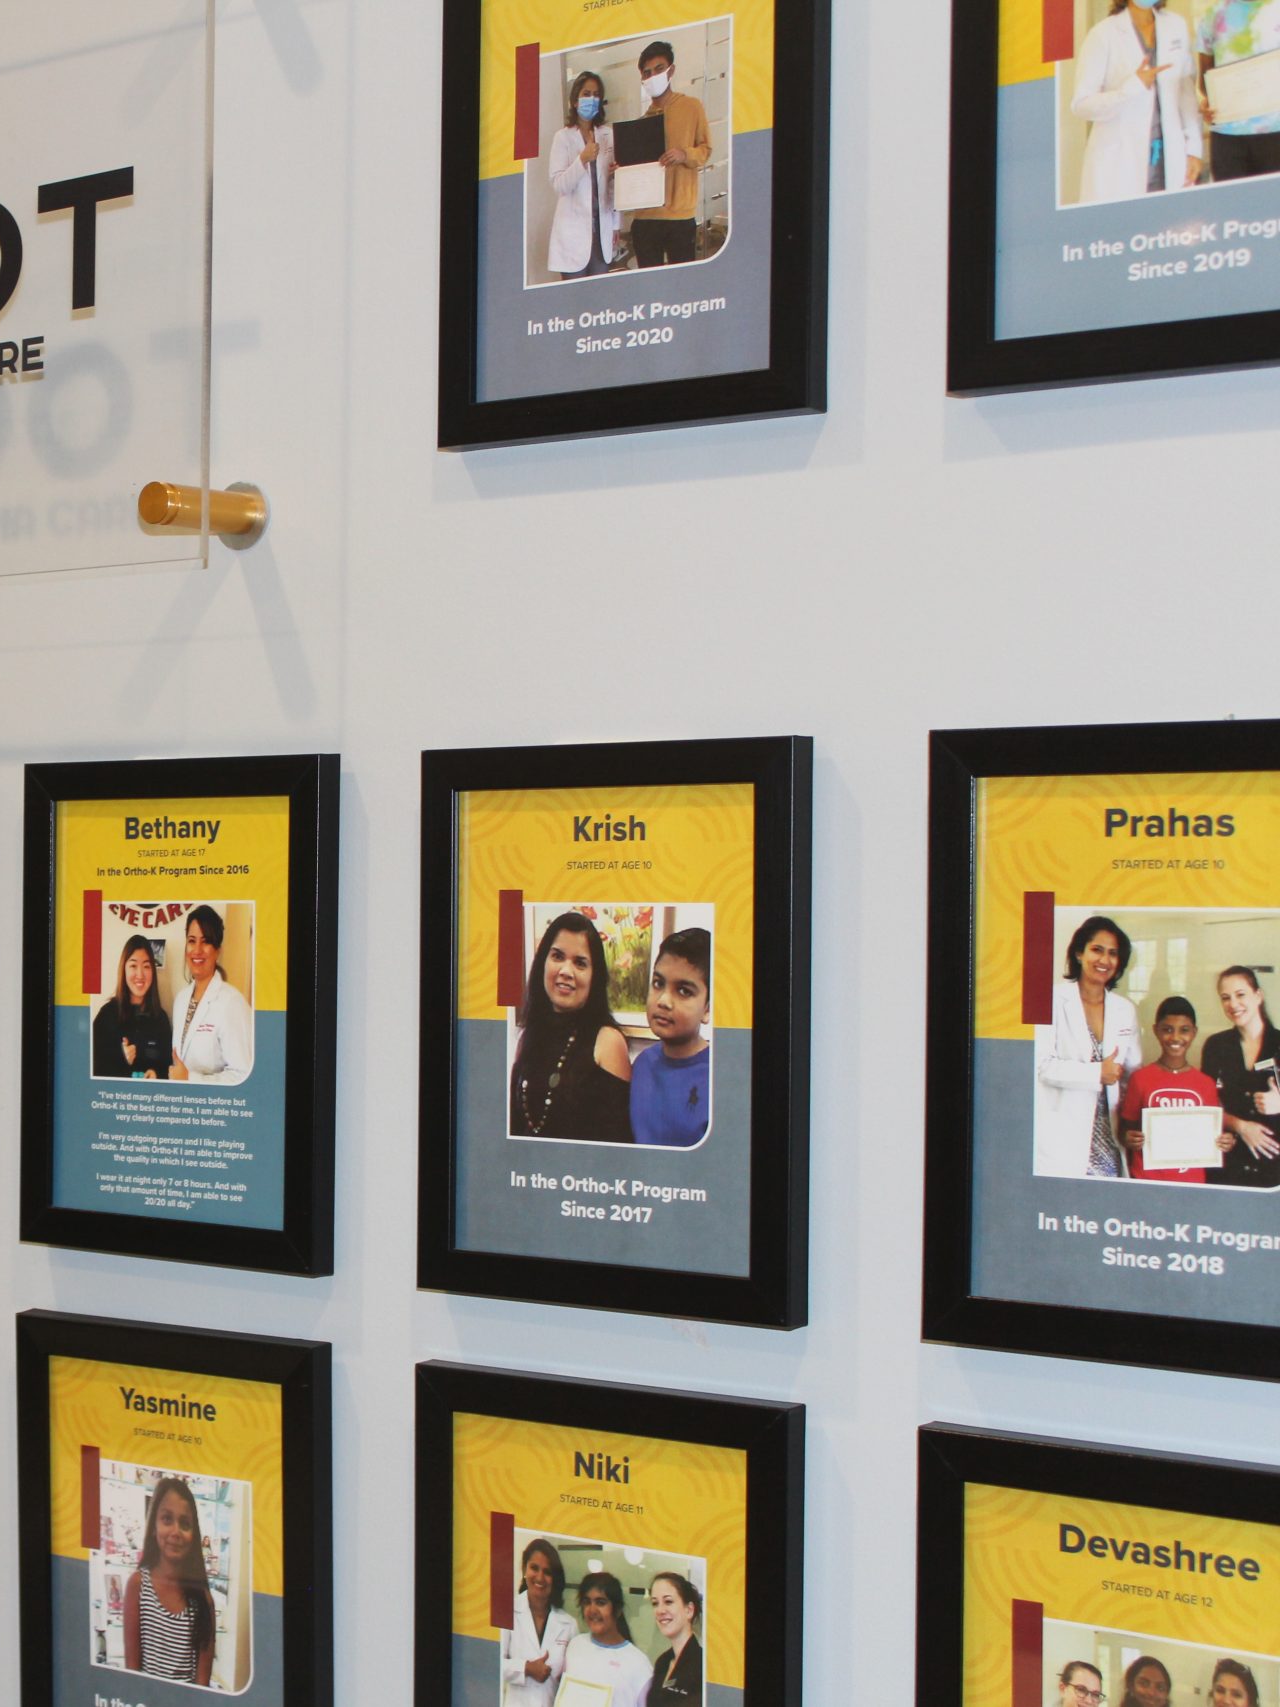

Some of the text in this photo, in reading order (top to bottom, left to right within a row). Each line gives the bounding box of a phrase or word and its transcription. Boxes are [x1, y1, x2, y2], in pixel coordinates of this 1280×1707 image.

[1062, 245, 1083, 262] In
[1090, 240, 1123, 258] the
[1130, 225, 1216, 251] Ortho-K
[1128, 249, 1250, 281] Since 2019
[528, 297, 726, 335] In the Ortho-K Program
[576, 327, 673, 354] Since 2020
[125, 816, 221, 844] Bethany
[574, 814, 646, 841] Krish
[1104, 807, 1235, 838] Prahas
[138, 850, 169, 858] STARTED
[171, 849, 179, 857] AT
[182, 849, 196, 857] AGE
[567, 861, 652, 870] STARTED AT AGE 10
[1112, 859, 1225, 870] STARTED AT AGE 10
[97, 864, 249, 878] In the Ortho-K Program Since 2016
[91, 1101, 118, 1110] Ortho-K
[126, 1103, 138, 1111] the
[140, 1103, 155, 1112] best
[170, 1105, 180, 1113] for
[213, 1107, 229, 1116] able
[231, 1109, 238, 1117] to
[115, 1092, 131, 1100] tried
[133, 1094, 151, 1102] many
[153, 1094, 182, 1103] different
[184, 1096, 207, 1104] lenses
[208, 1097, 232, 1106] before
[234, 1098, 246, 1107] but
[116, 1113, 227, 1126] very clearly compared to before.
[510, 1171, 706, 1202] In the Ortho-K Program
[561, 1201, 652, 1223] Since 2017
[1038, 1212, 1058, 1231] In
[1064, 1215, 1098, 1234] the
[1104, 1218, 1191, 1243] Ortho-K
[1102, 1247, 1224, 1275] Since 2018
[120, 1386, 216, 1421] Yasmine
[133, 1428, 164, 1440] STARTED
[167, 1432, 175, 1441] AT
[178, 1434, 192, 1444] AGE
[574, 1451, 629, 1484] Niki
[560, 1493, 644, 1515] STARTED AT AGE 11
[1059, 1523, 1260, 1581] Devashree
[1102, 1580, 1213, 1608] STARTED AT AGE 12
[95, 1694, 132, 1707] In the
